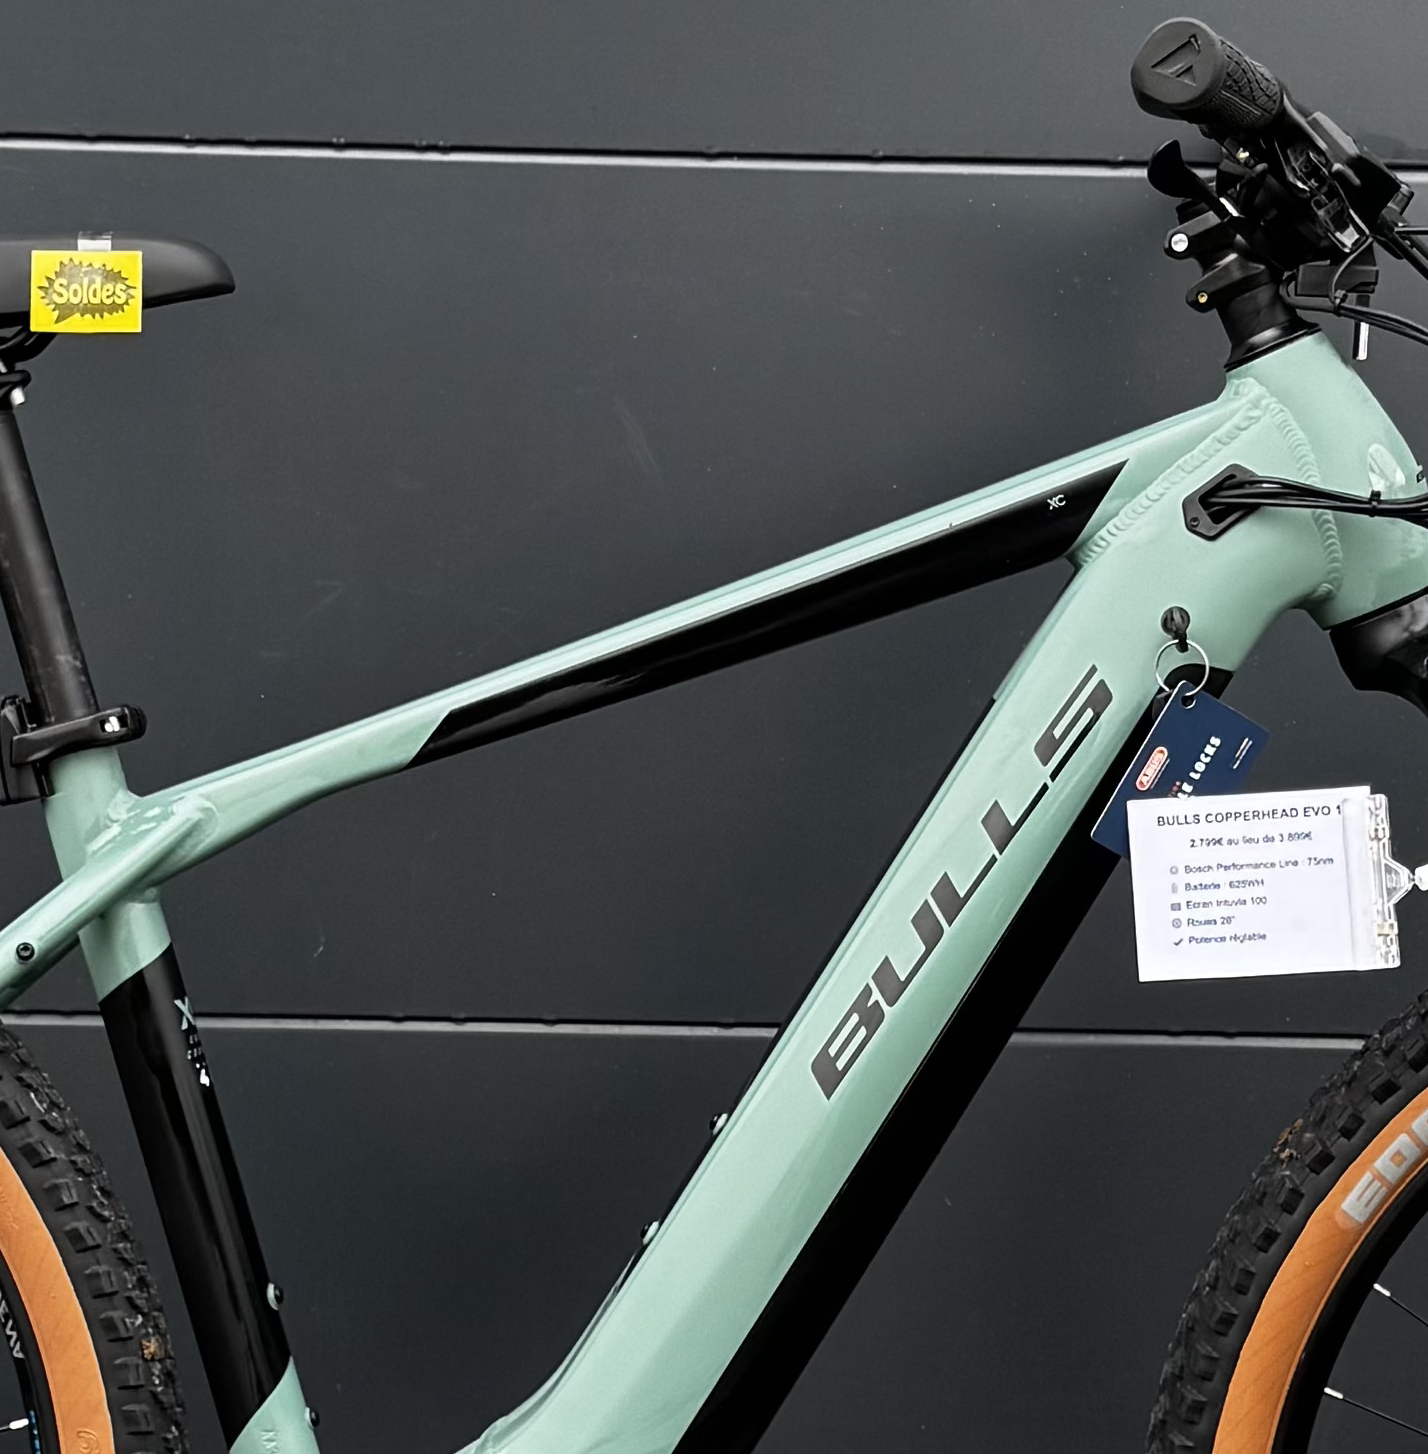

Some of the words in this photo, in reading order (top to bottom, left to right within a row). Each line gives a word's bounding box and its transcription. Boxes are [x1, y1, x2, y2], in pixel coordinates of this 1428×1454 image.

[52, 278, 127, 305] Soldes
[1189, 736, 1221, 780] LOCKS
[1157, 813, 1201, 827] BULLS
[1205, 808, 1299, 824] COPPERHEAD
[1303, 805, 1331, 818] EVO
[1336, 804, 1342, 815] 1
[1184, 864, 1213, 875] Bosch
[1216, 861, 1276, 872] Performance
[1279, 859, 1299, 869] Line
[811, 664, 1113, 1101] BULLS
[1250, 896, 1267, 905] 100
